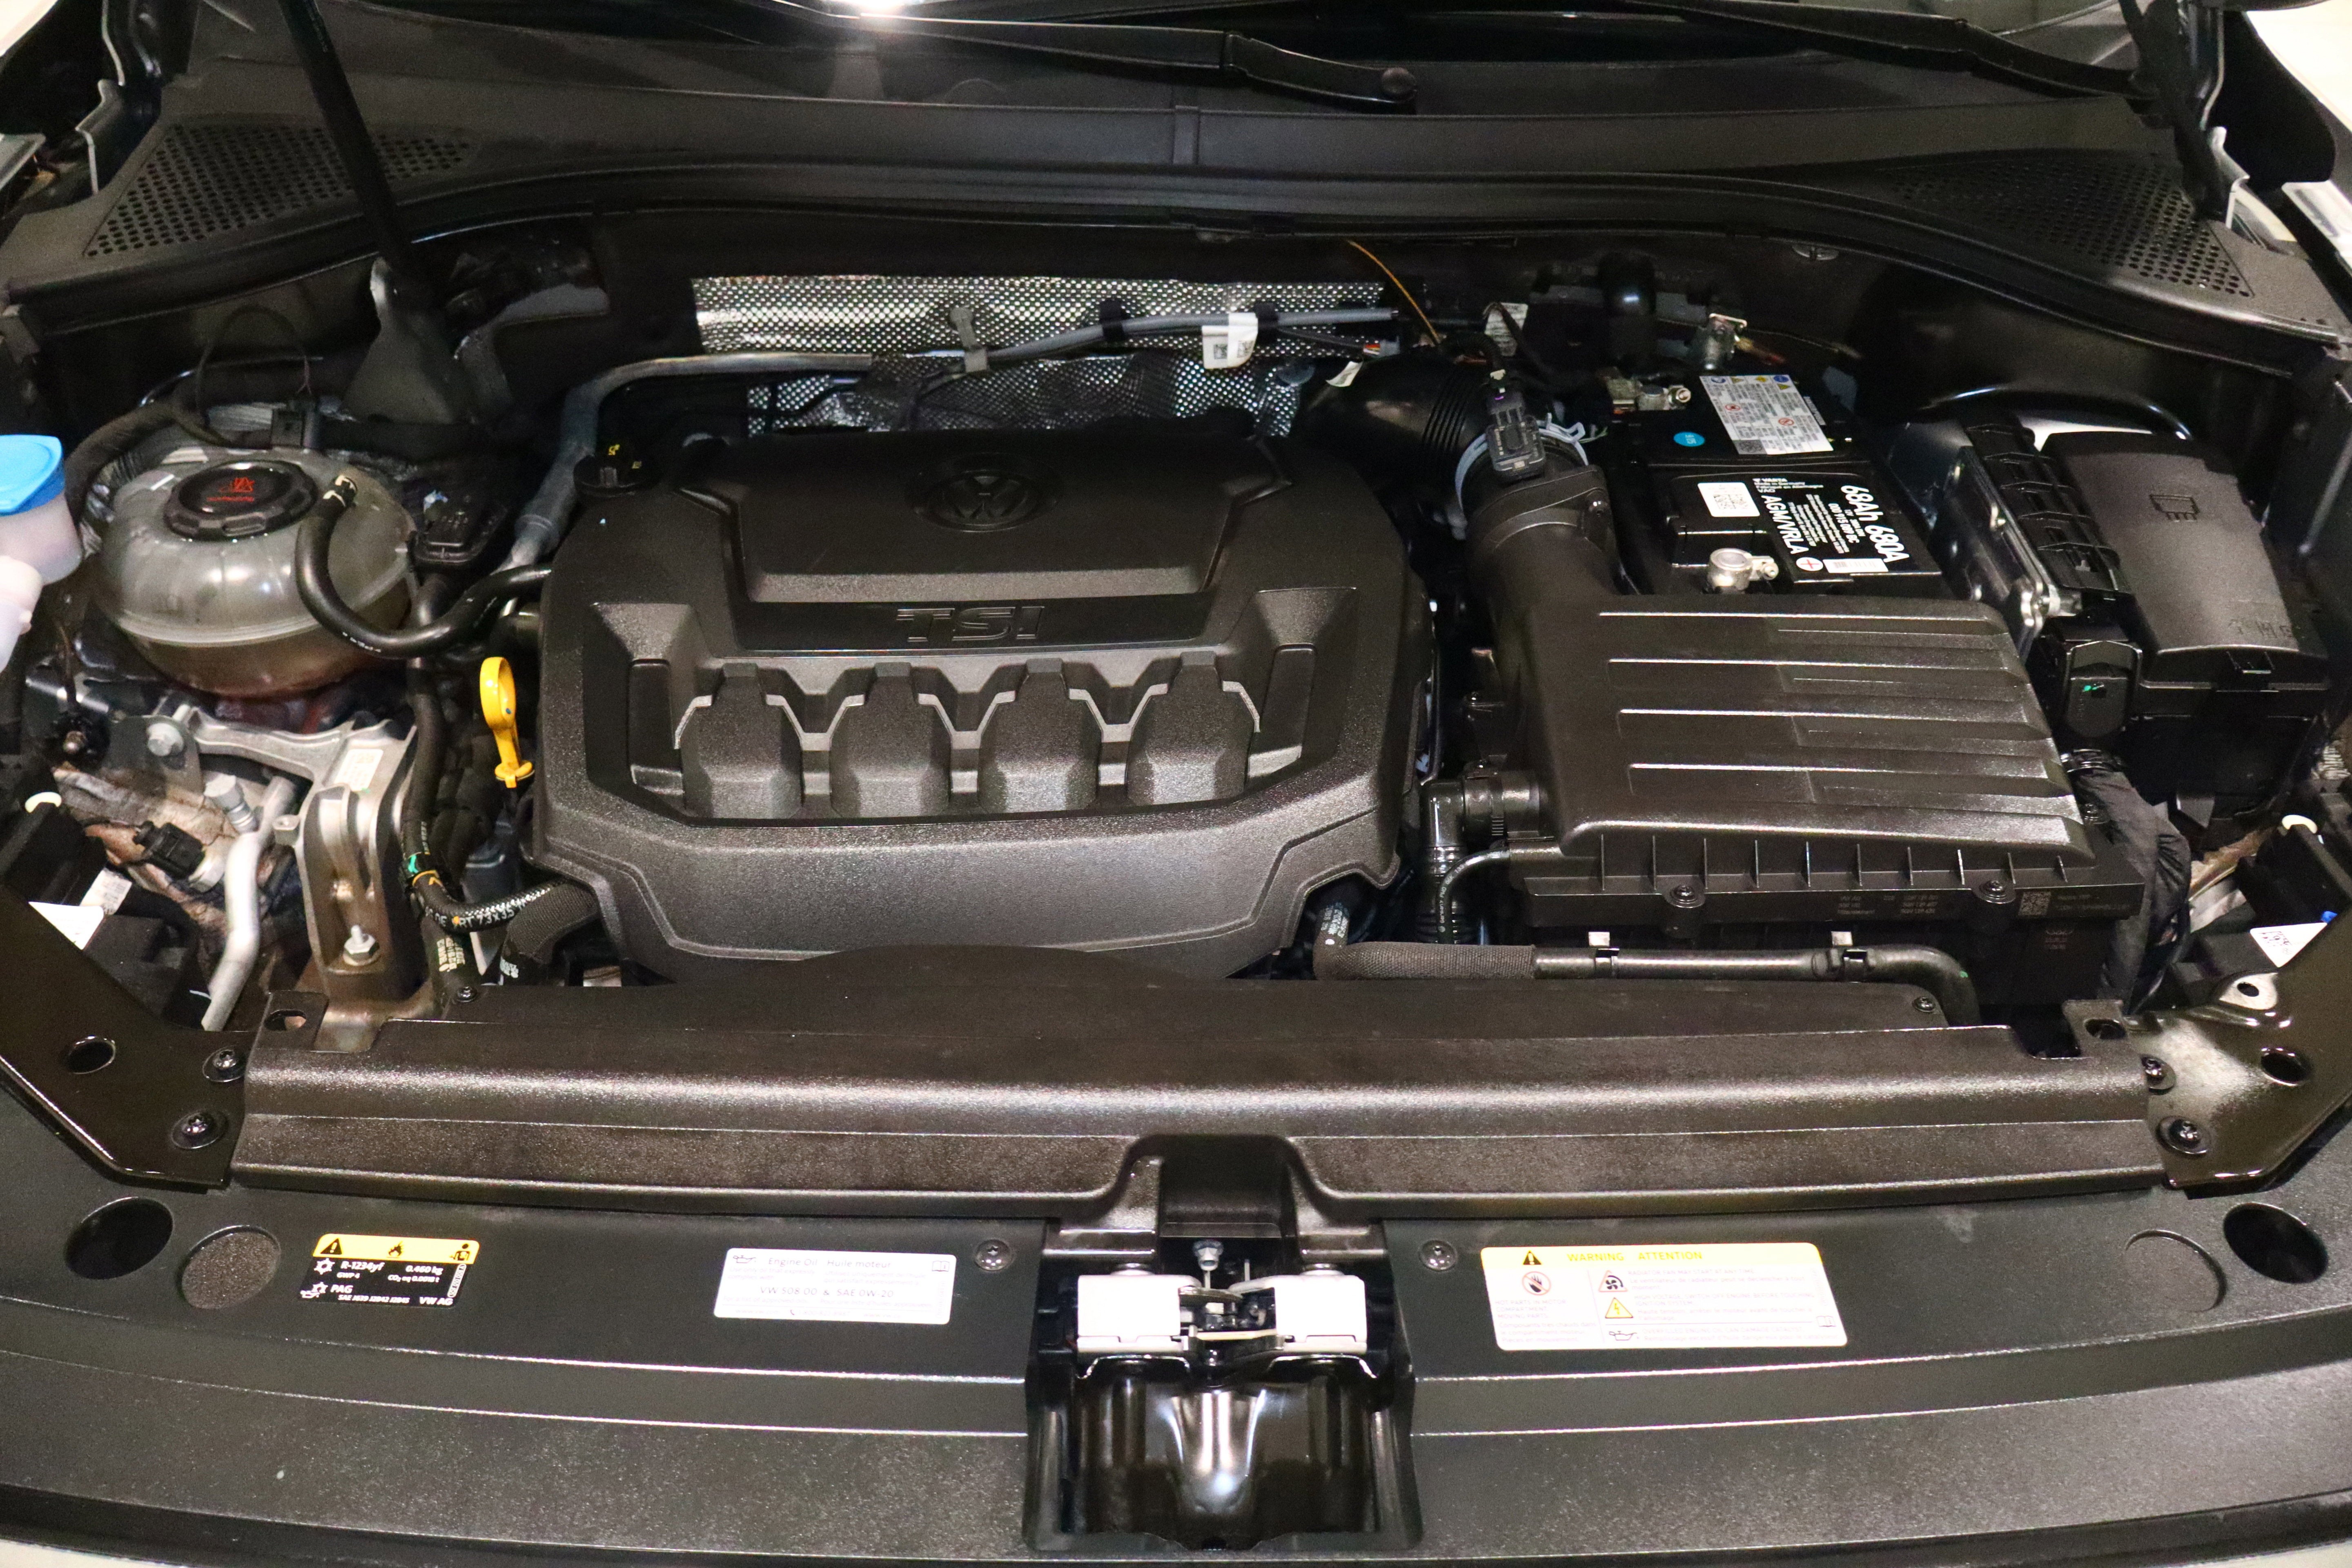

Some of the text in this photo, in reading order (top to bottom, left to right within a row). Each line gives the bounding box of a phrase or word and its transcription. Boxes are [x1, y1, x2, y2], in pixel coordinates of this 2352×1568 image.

[1834, 513, 1849, 524] 915
[1845, 534, 1860, 543] BC
[1840, 485, 1884, 521] 68Ah
[1864, 525, 1910, 563] 680A
[896, 606, 1045, 642] TSI
[768, 1257, 801, 1267] Engine
[1567, 1251, 1703, 1262] WARNING ATTENTION
[341, 1261, 385, 1273] R-1234yf
[432, 1266, 443, 1275] kg
[330, 1284, 354, 1294] PAG
[859, 1290, 894, 1298] 0W-20
[419, 1296, 437, 1305] VW
